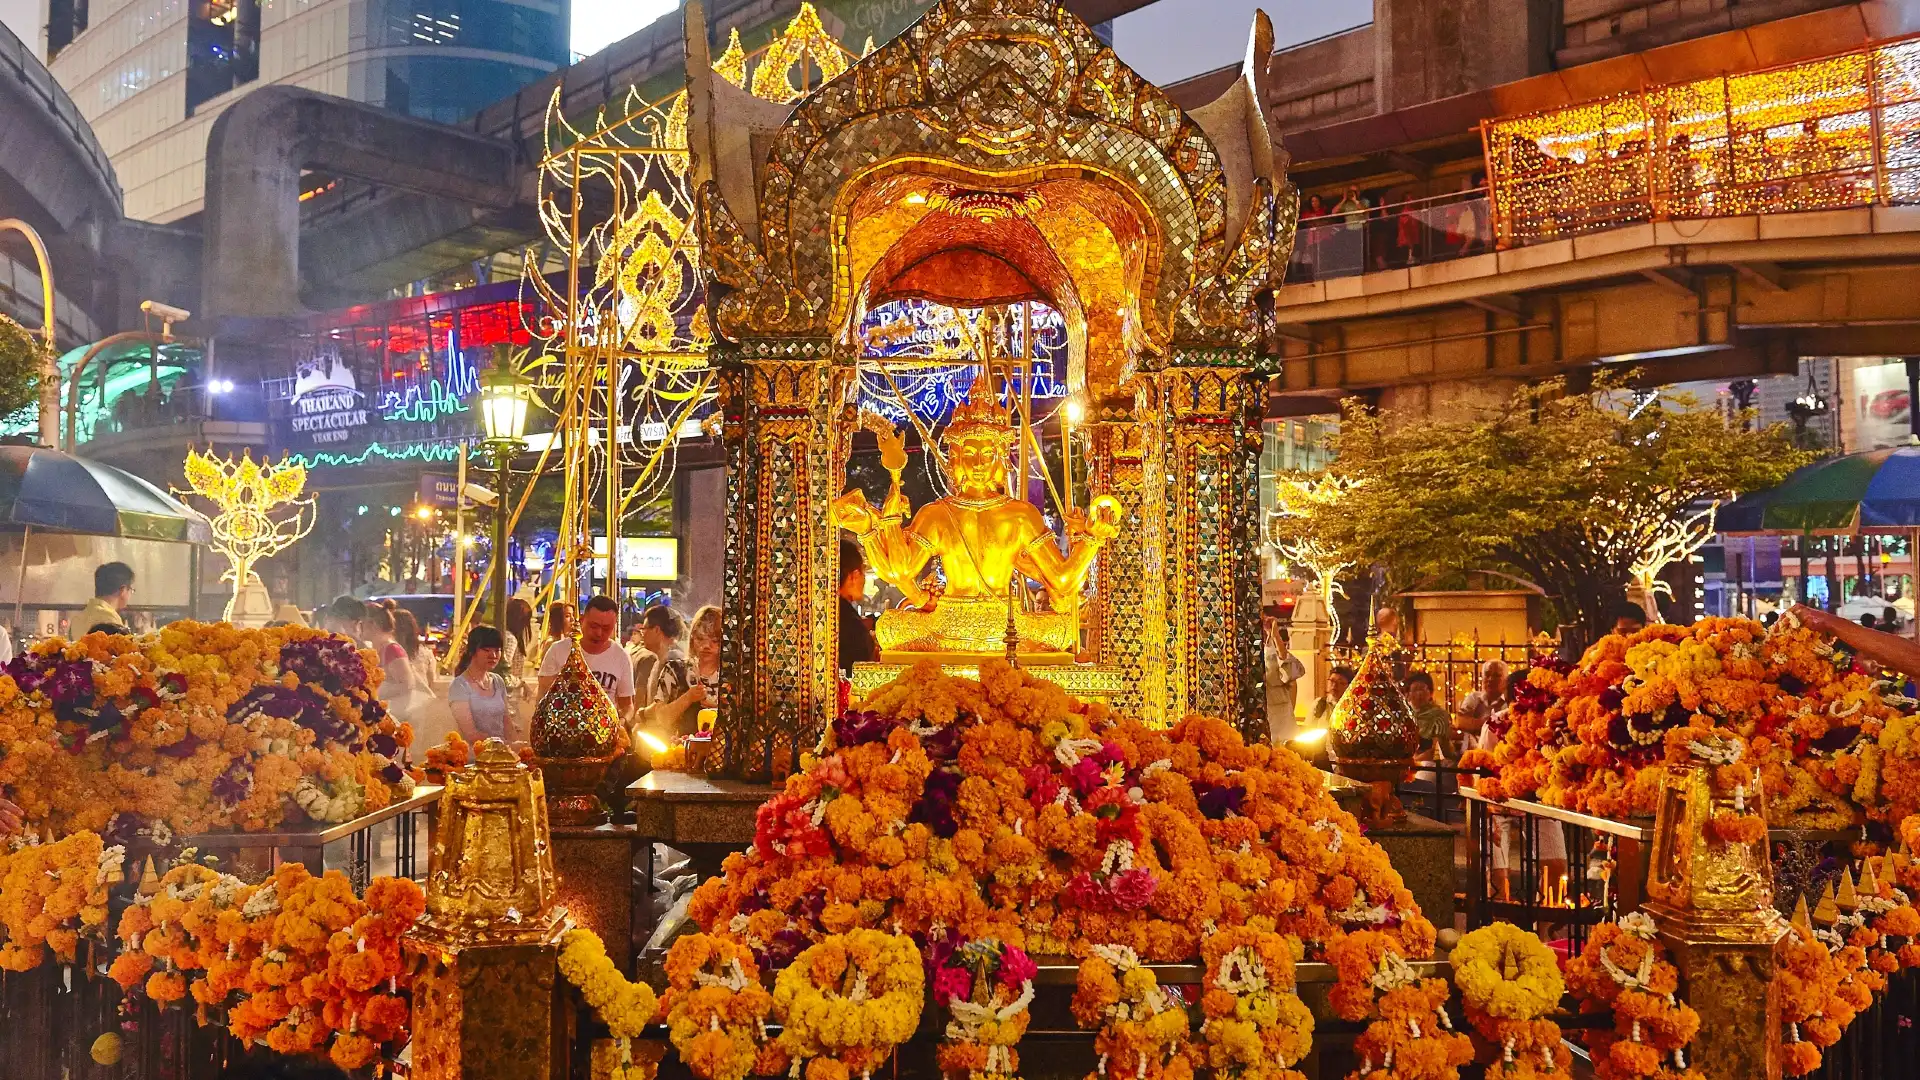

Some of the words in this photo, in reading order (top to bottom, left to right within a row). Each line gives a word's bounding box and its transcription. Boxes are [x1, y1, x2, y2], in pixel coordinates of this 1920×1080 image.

[300, 394, 354, 414] THAILAND
[292, 410, 367, 432] SPECTACULAR
[312, 432, 333, 443] YEAR
[333, 430, 348, 442] END
[643, 426, 665, 437] VISA
[47, 623, 54, 634] 8
